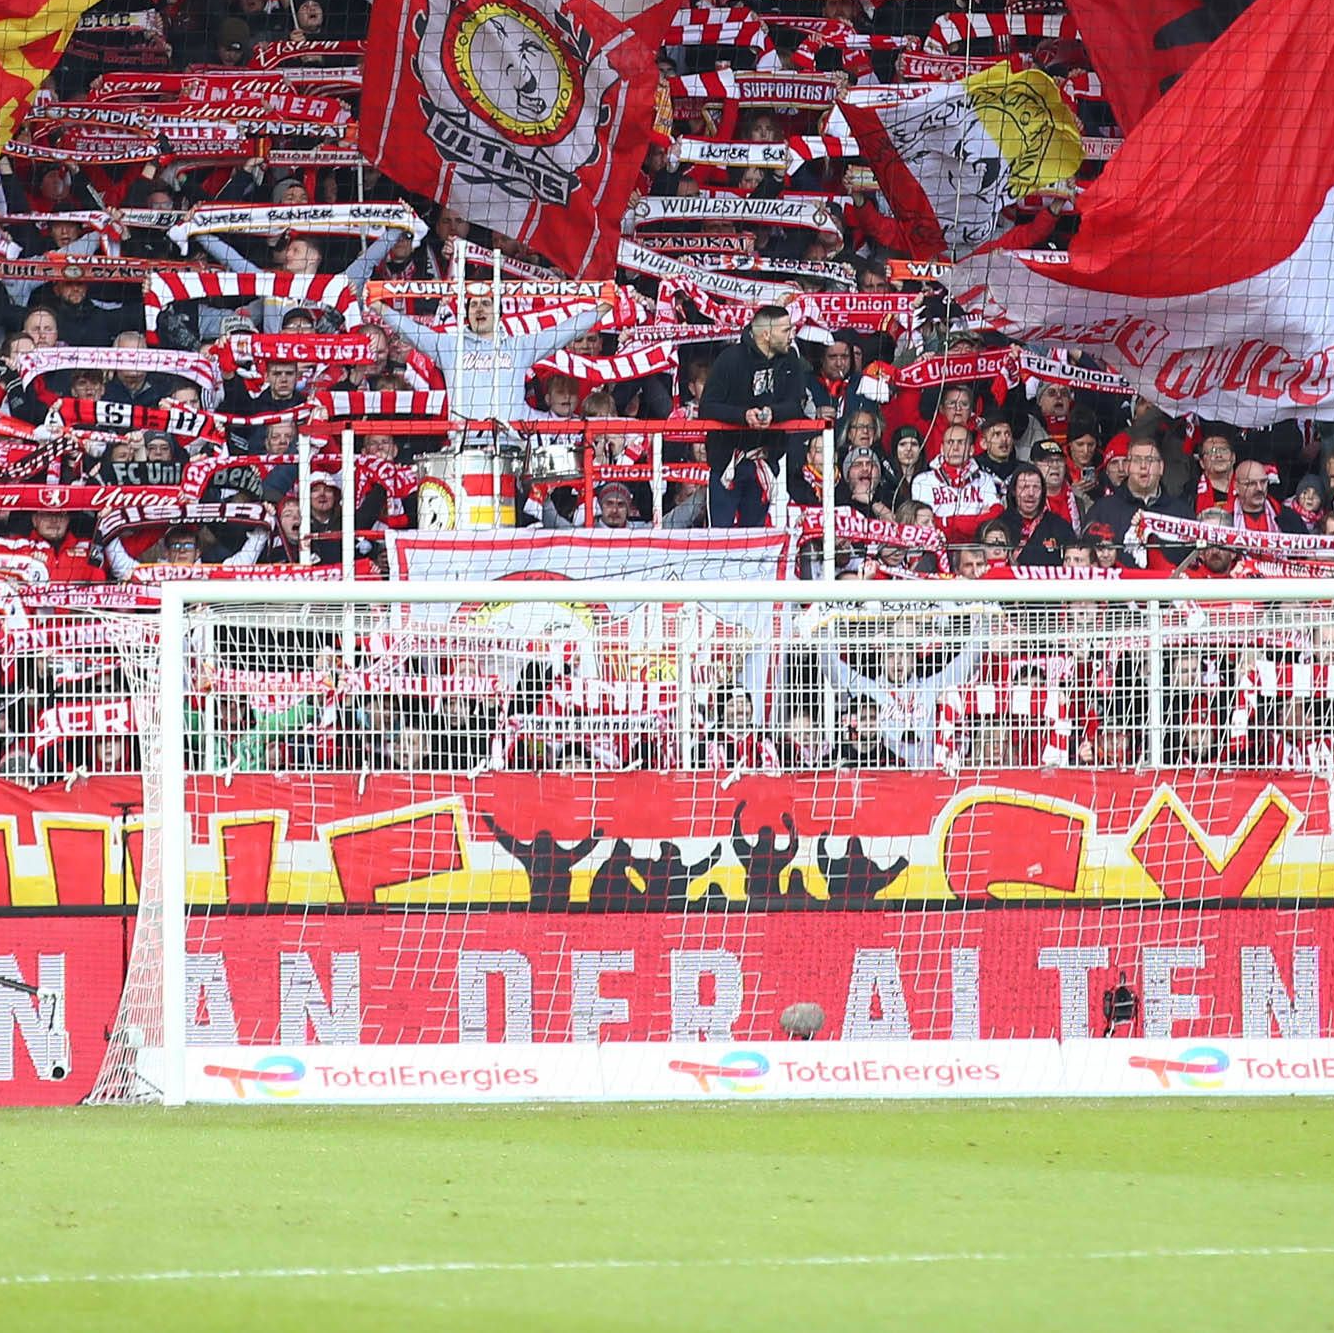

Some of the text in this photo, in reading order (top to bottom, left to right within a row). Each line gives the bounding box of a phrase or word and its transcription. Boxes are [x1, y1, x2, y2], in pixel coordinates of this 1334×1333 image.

[254, 38, 340, 66] Eisern
[743, 81, 823, 101] SUPPORTERS
[431, 119, 567, 203] ULTRAS
[266, 209, 335, 223] BUNTER
[661, 198, 805, 219] WUHLESYNDIKAT
[633, 248, 765, 298] WUHLESYNDIKAT
[820, 297, 893, 312] FC Union
[926, 356, 972, 380] Union
[1026, 355, 1109, 384] Für Union
[117, 463, 140, 485] FC
[92, 487, 182, 509] Union
[168, 515, 228, 526] UNION
[1142, 514, 1229, 544] SCHULTER
[1236, 530, 1264, 549] AN
[184, 950, 361, 1046] AN
[458, 947, 744, 1043] DER
[840, 945, 1321, 1041] ALTEN
[315, 1064, 539, 1092] TotalEnergies
[777, 1059, 1001, 1086] TotalEnergies
